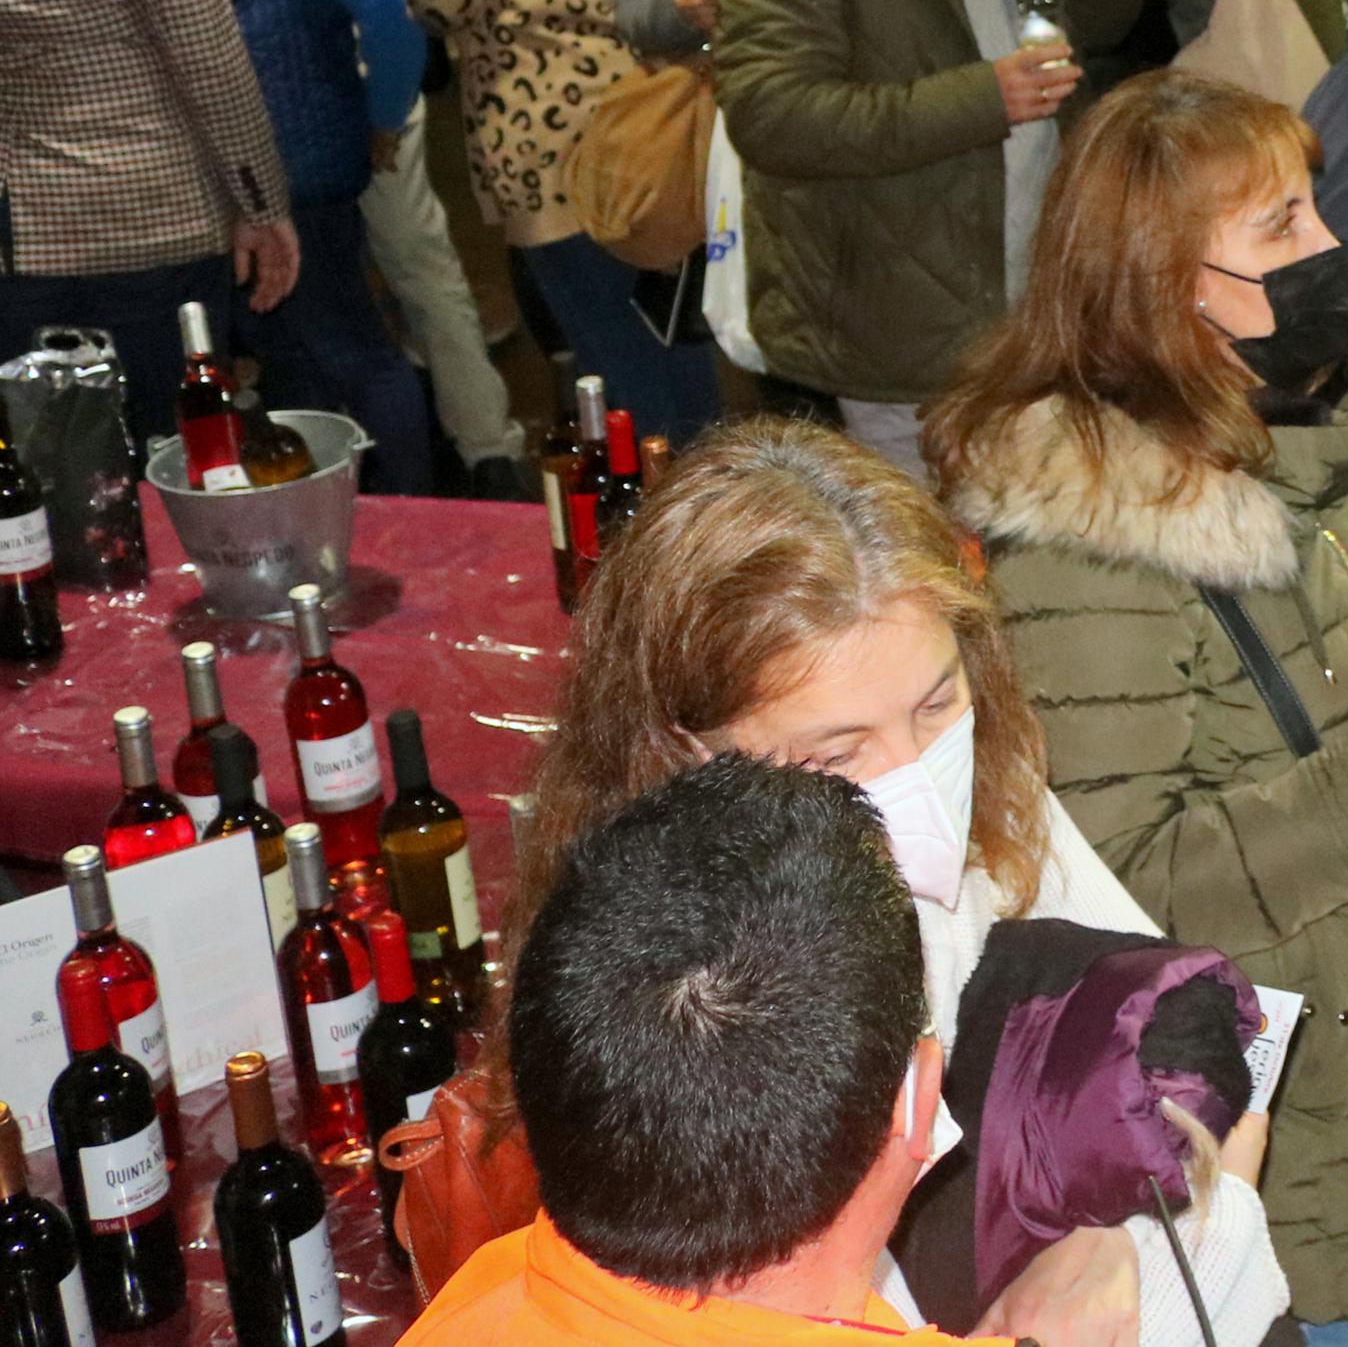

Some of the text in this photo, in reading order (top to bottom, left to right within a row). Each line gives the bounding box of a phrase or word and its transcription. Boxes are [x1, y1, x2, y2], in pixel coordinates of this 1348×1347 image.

[313, 758, 353, 777] QUINTA
[140, 1029, 164, 1054] QUIN
[105, 1157, 153, 1188] QUINTA
